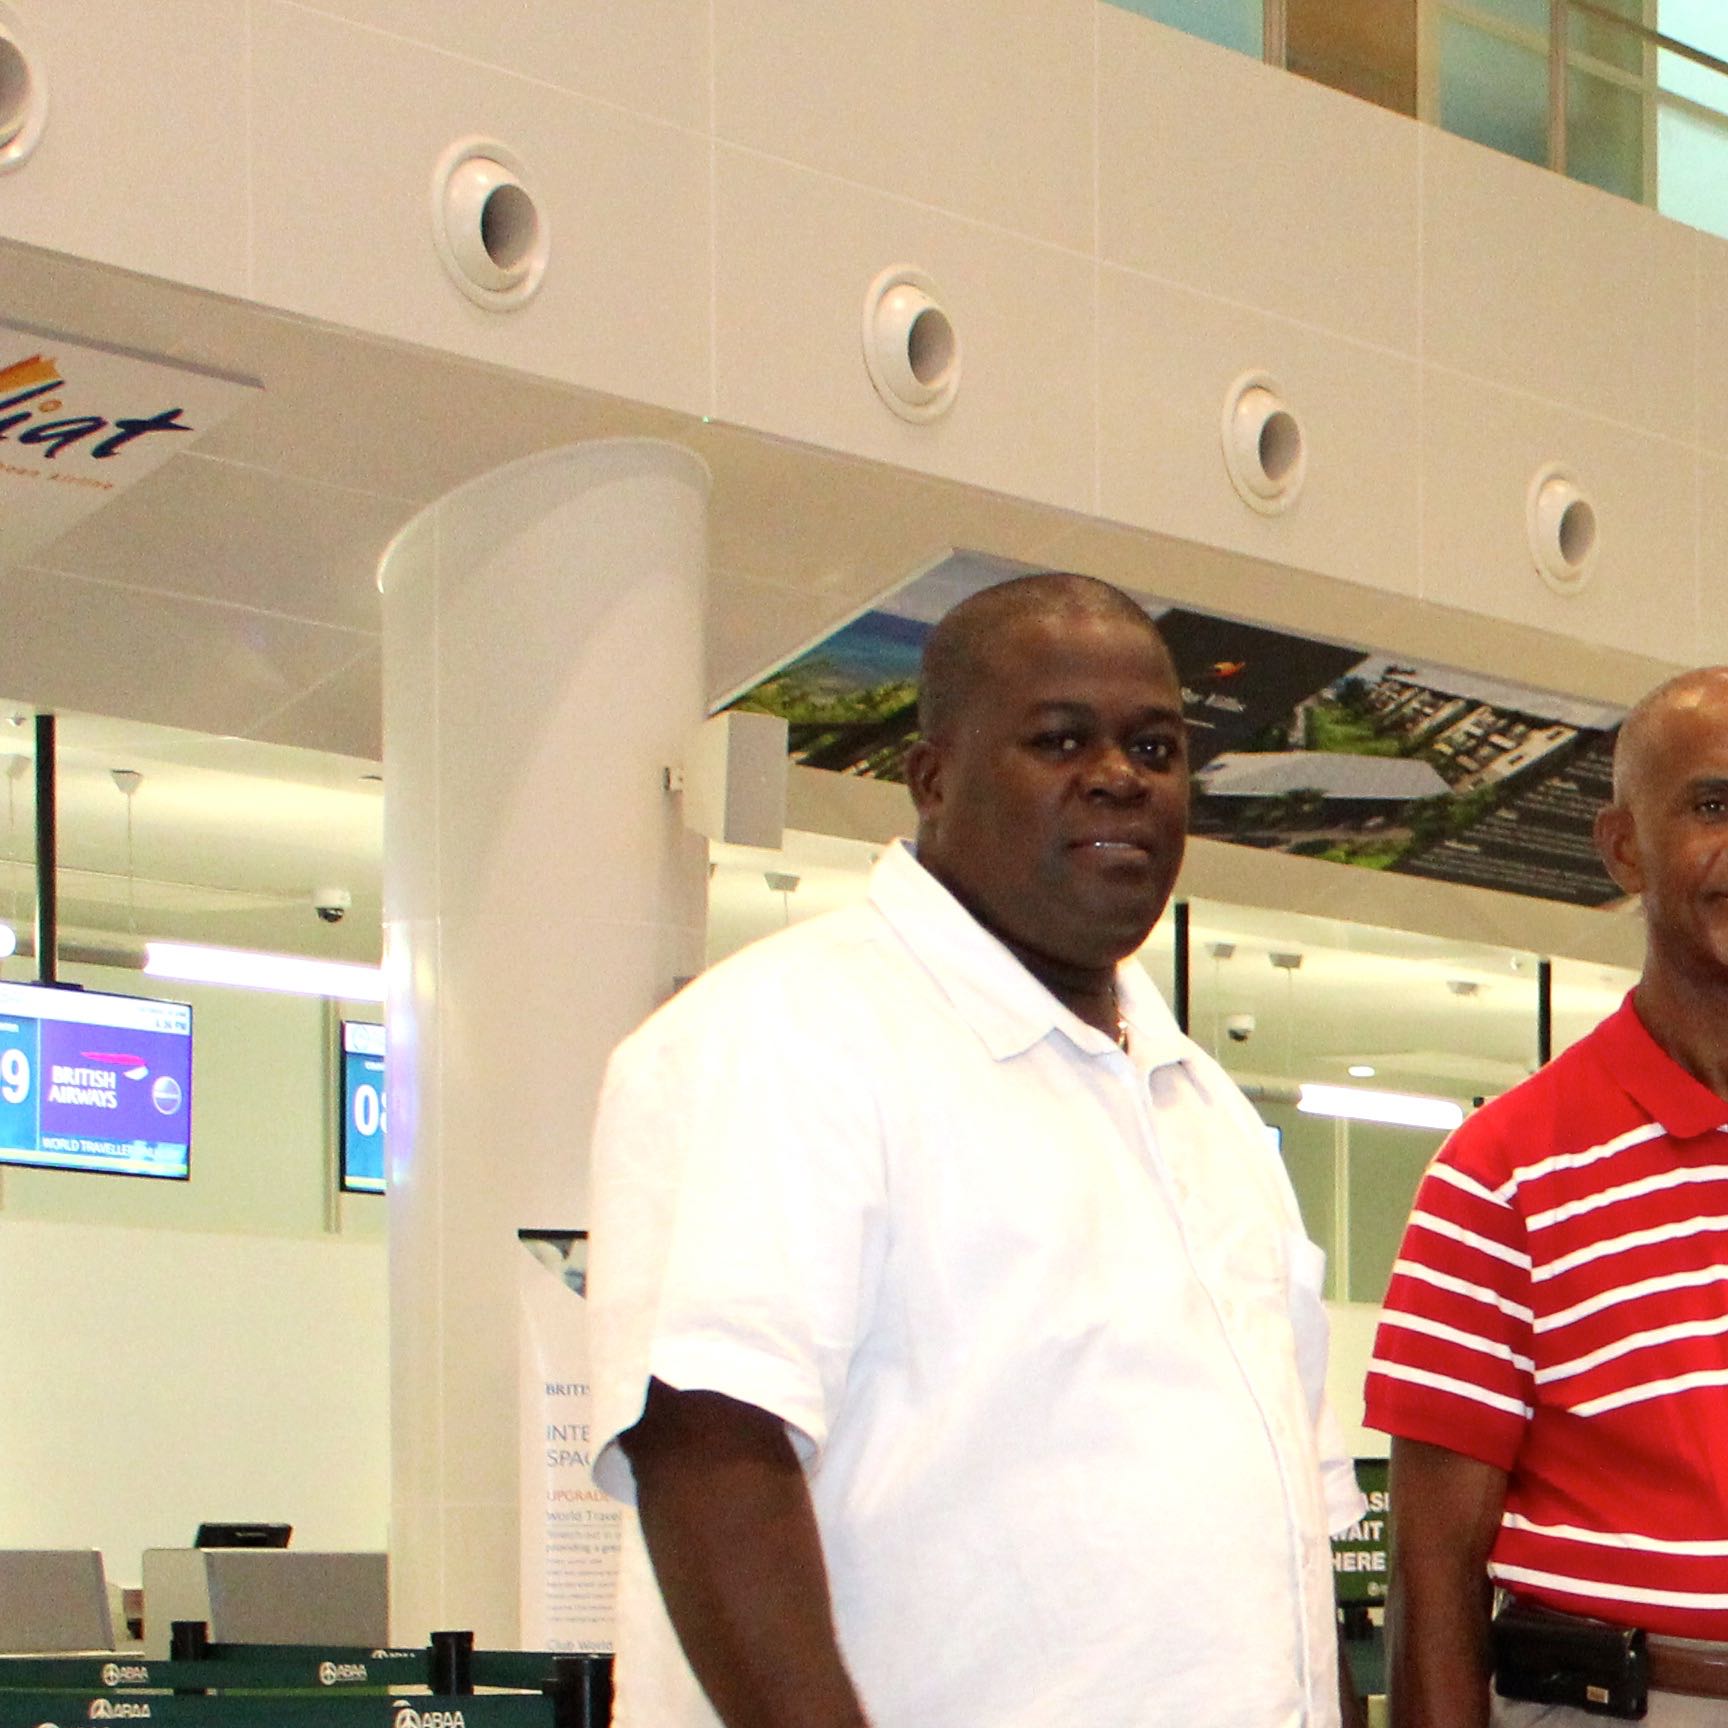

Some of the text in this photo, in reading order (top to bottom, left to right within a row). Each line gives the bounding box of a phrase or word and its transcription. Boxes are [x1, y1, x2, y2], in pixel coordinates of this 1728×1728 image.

[52, 1065, 117, 1090] BRITISH
[49, 1085, 118, 1110] AIRWAYS
[42, 1136, 81, 1153] WORLD
[1332, 1552, 1387, 1572] HERE
